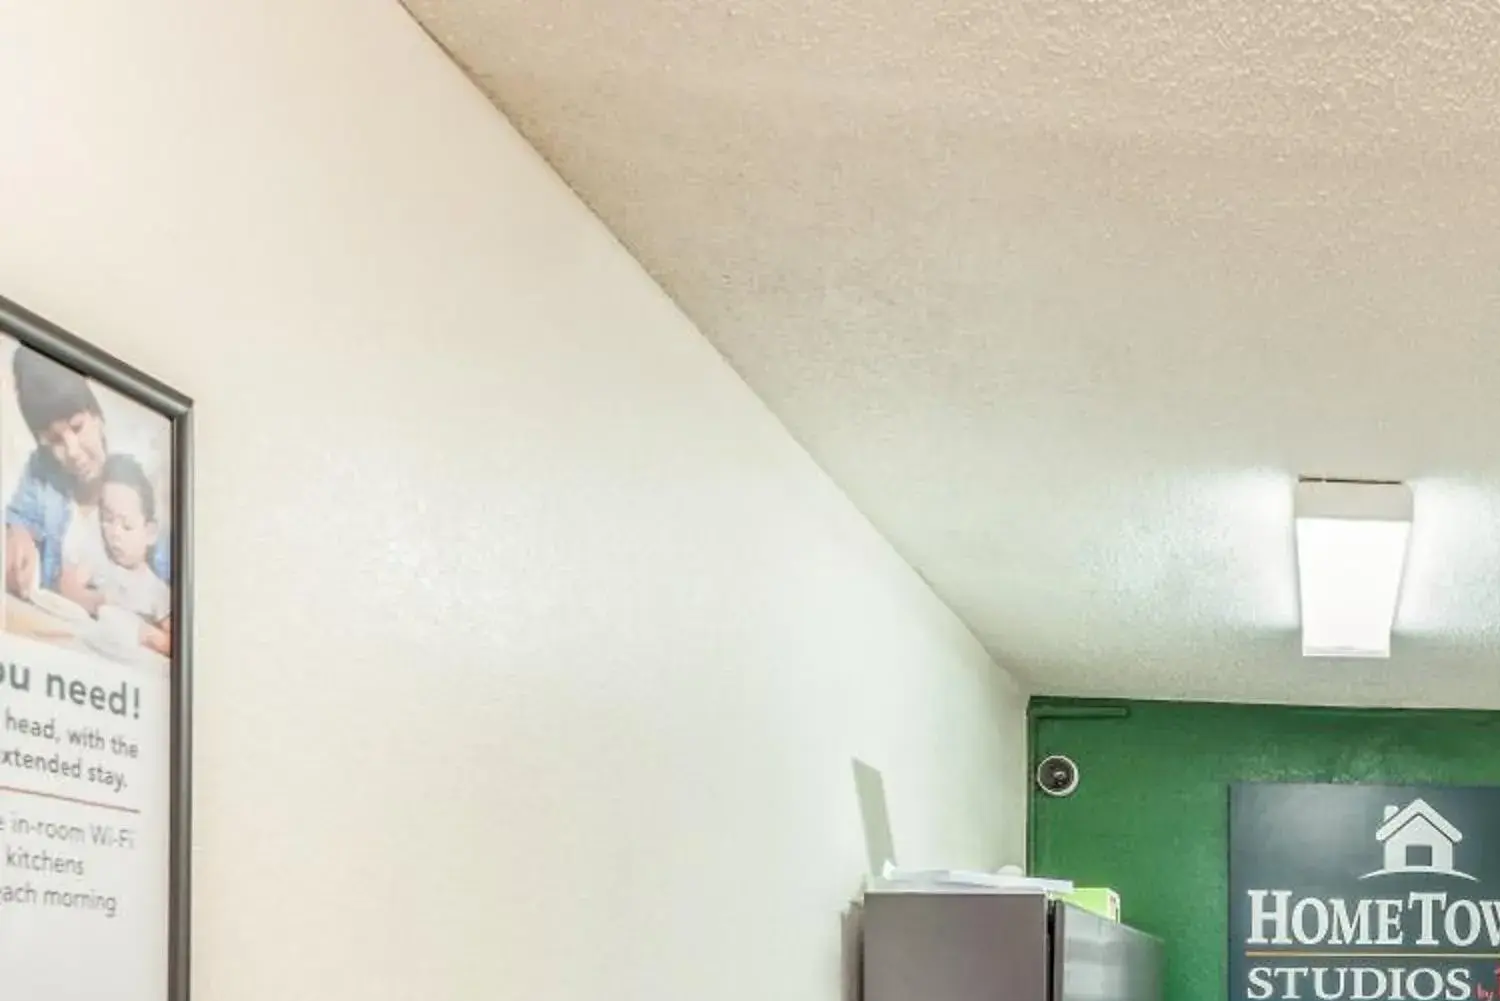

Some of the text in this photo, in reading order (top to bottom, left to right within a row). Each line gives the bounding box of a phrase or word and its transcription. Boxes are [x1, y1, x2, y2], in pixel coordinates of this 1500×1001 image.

[46, 672, 140, 720] need!
[5, 705, 140, 758] head, with the
[87, 766, 128, 794] stay.
[10, 811, 86, 845] in-room
[88, 822, 137, 850] Wi-Fi
[6, 844, 85, 876] kitchens
[0, 881, 118, 919] ach morning
[1247, 967, 1472, 1001] STUDIOS
